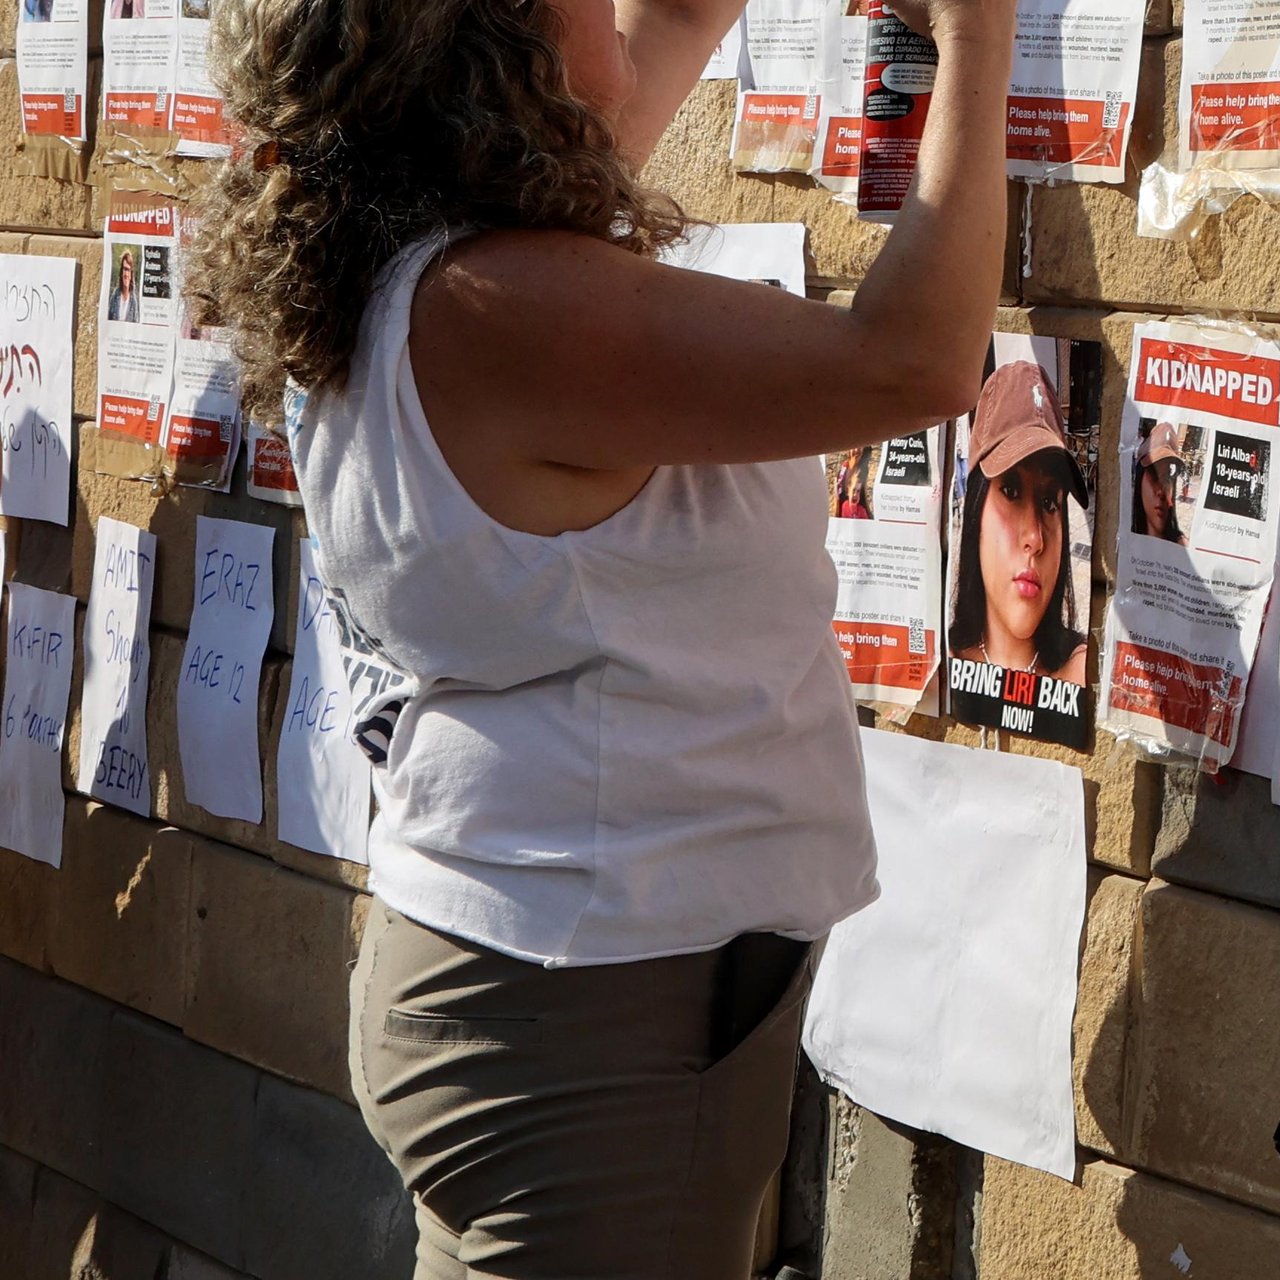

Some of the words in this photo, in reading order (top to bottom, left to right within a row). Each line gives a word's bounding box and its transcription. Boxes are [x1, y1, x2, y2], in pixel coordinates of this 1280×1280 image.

[1146, 357, 1272, 405] KIDNAPPED
[200, 549, 260, 611] ERAZ
[188, 646, 223, 687] AGE
[228, 662, 244, 704] 12
[951, 658, 1006, 698] BRING
[1004, 670, 1036, 705] LIRI
[1038, 676, 1080, 717] BACK
[290, 678, 338, 732] AGE
[1001, 705, 1034, 733] NOW!
